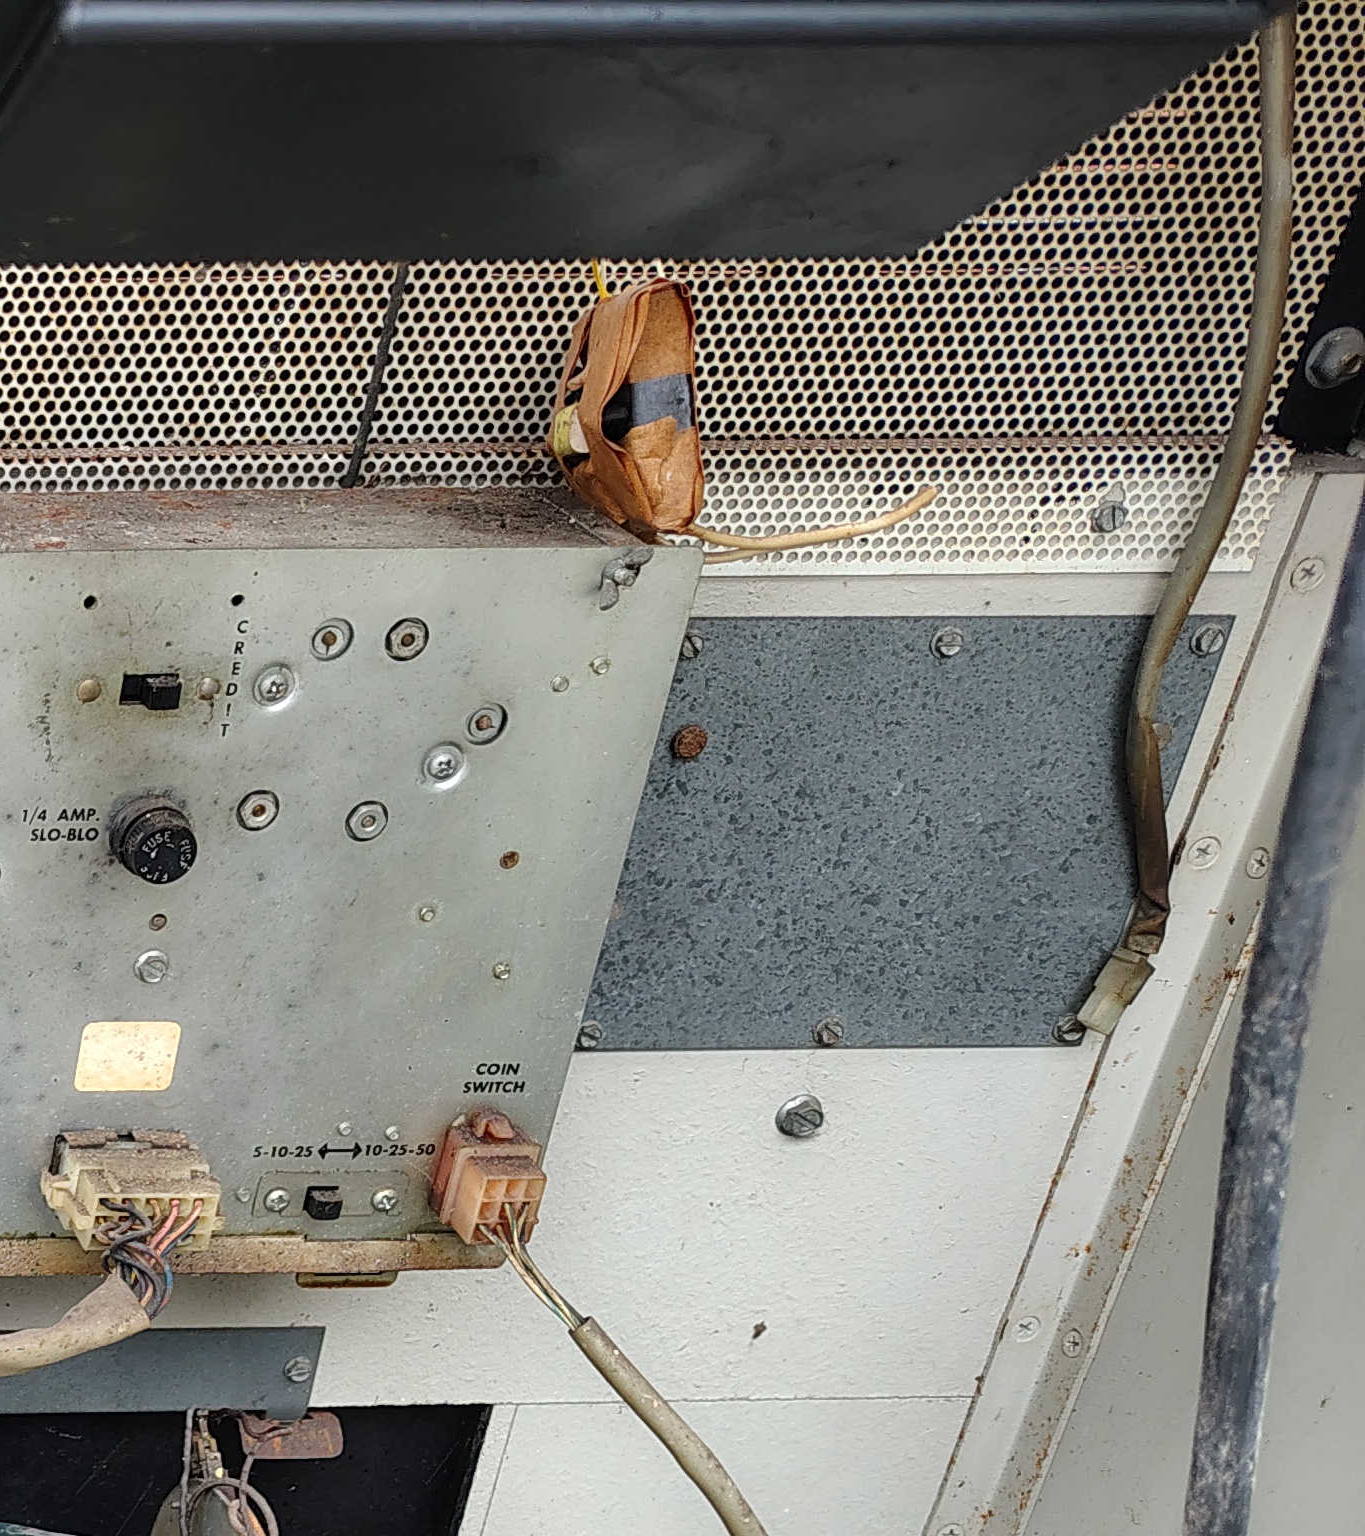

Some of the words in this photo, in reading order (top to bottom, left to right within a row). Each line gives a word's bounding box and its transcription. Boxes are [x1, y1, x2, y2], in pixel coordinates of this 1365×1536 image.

[220, 620, 250, 738] CREDIT
[22, 806, 48, 825] 1/4
[56, 807, 100, 822] AMP.
[30, 827, 100, 842] SLO-BLO
[142, 831, 172, 853] FUSE
[475, 1063, 521, 1076] COIN
[462, 1081, 526, 1094] SWITCH
[252, 1145, 314, 1158] 5-10-25
[364, 1144, 436, 1156] 10-25-50
